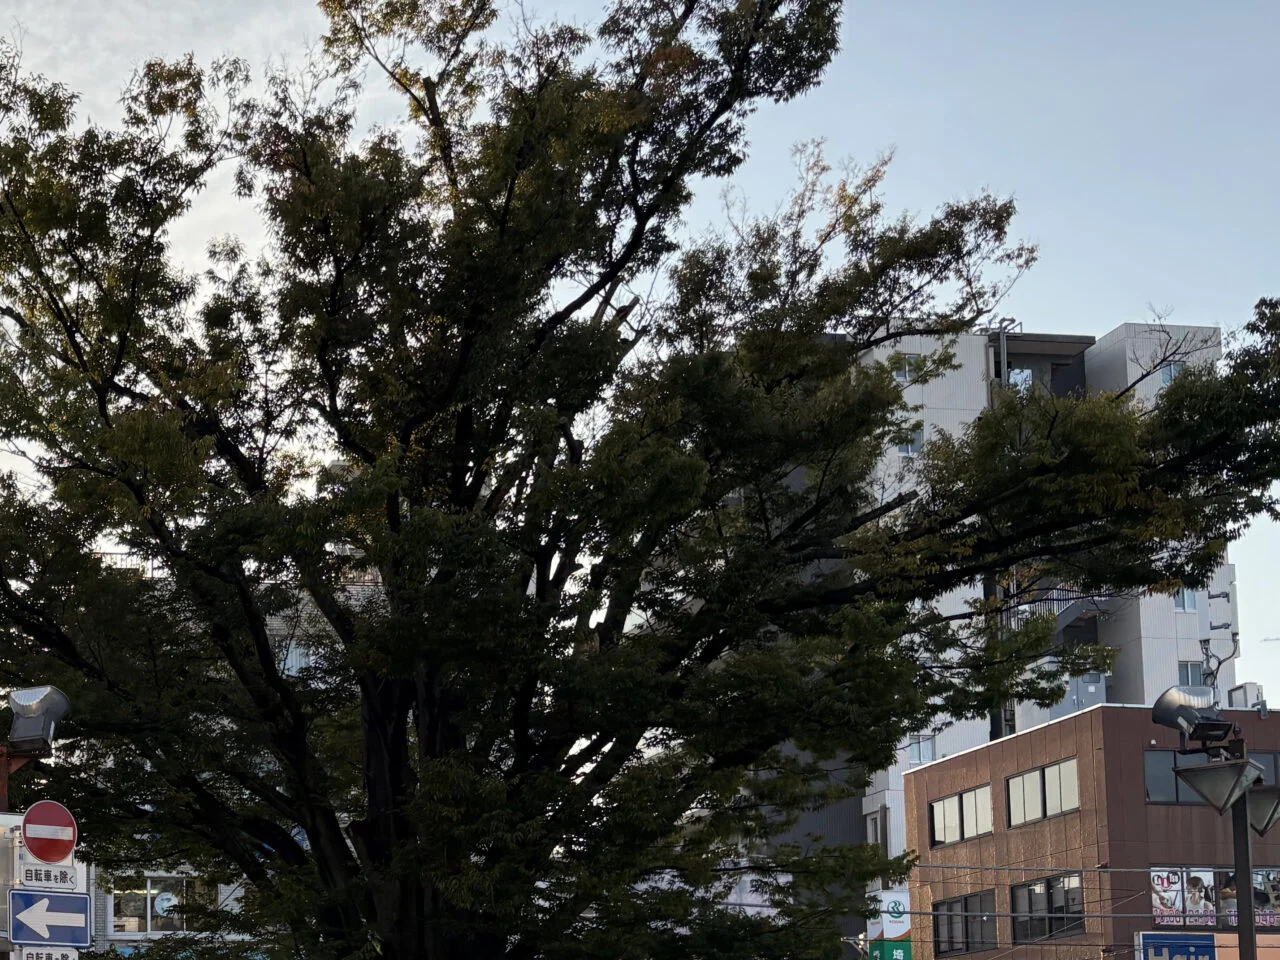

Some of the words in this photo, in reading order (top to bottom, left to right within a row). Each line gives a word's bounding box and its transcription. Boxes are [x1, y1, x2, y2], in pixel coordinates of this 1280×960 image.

[25, 869, 74, 885] 自転車を除く
